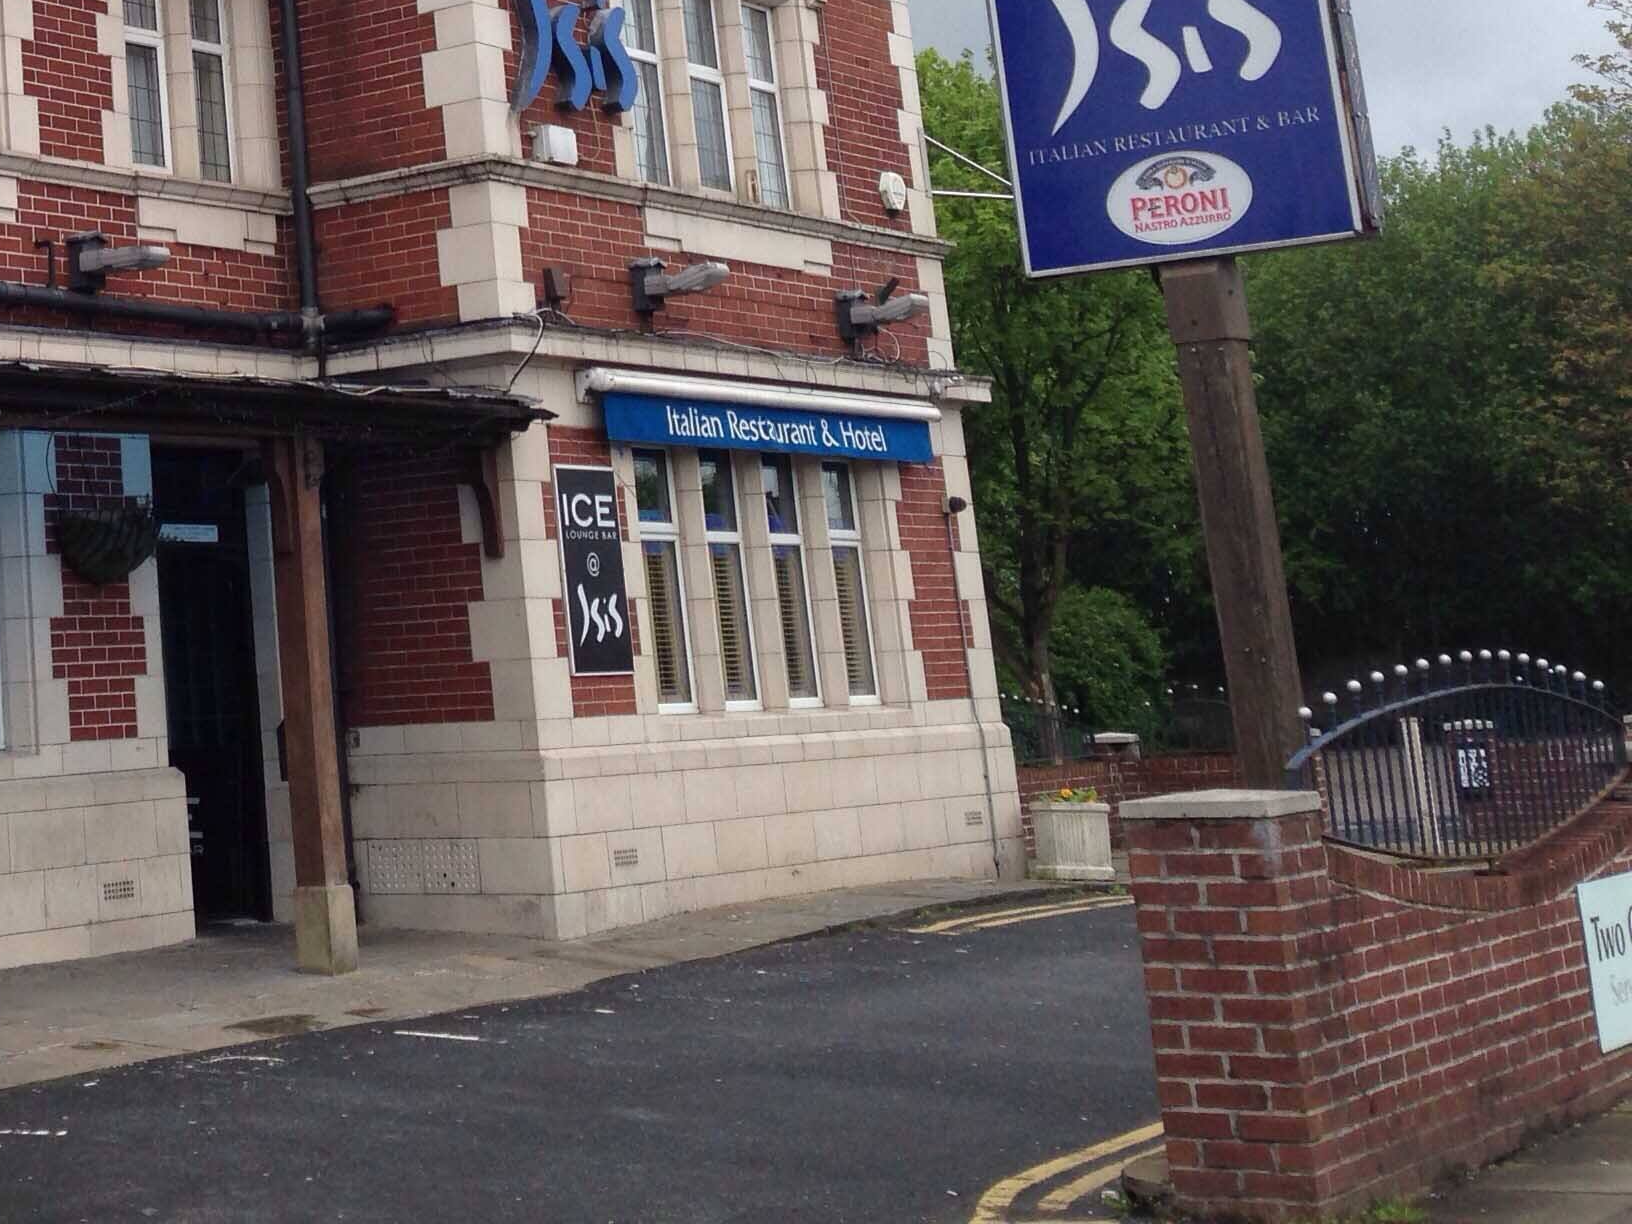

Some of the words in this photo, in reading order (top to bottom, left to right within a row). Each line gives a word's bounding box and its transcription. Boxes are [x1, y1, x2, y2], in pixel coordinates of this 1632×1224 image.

[1029, 139, 1108, 167] ITALIAN
[1114, 116, 1250, 150] RESTAURANT
[1256, 114, 1271, 131] &
[1277, 106, 1320, 127] BAR
[1130, 187, 1230, 222] PERONI
[1134, 219, 1178, 233] NASTRO
[1179, 213, 1232, 226] AZZURRO
[666, 405, 724, 438] Italian
[726, 410, 818, 446] Restaurant
[821, 419, 839, 448] &
[840, 421, 888, 452] Hotel
[562, 493, 616, 527] ICE
[566, 530, 599, 540] LOUNGE
[601, 531, 618, 540] BAR
[587, 552, 600, 577] @
